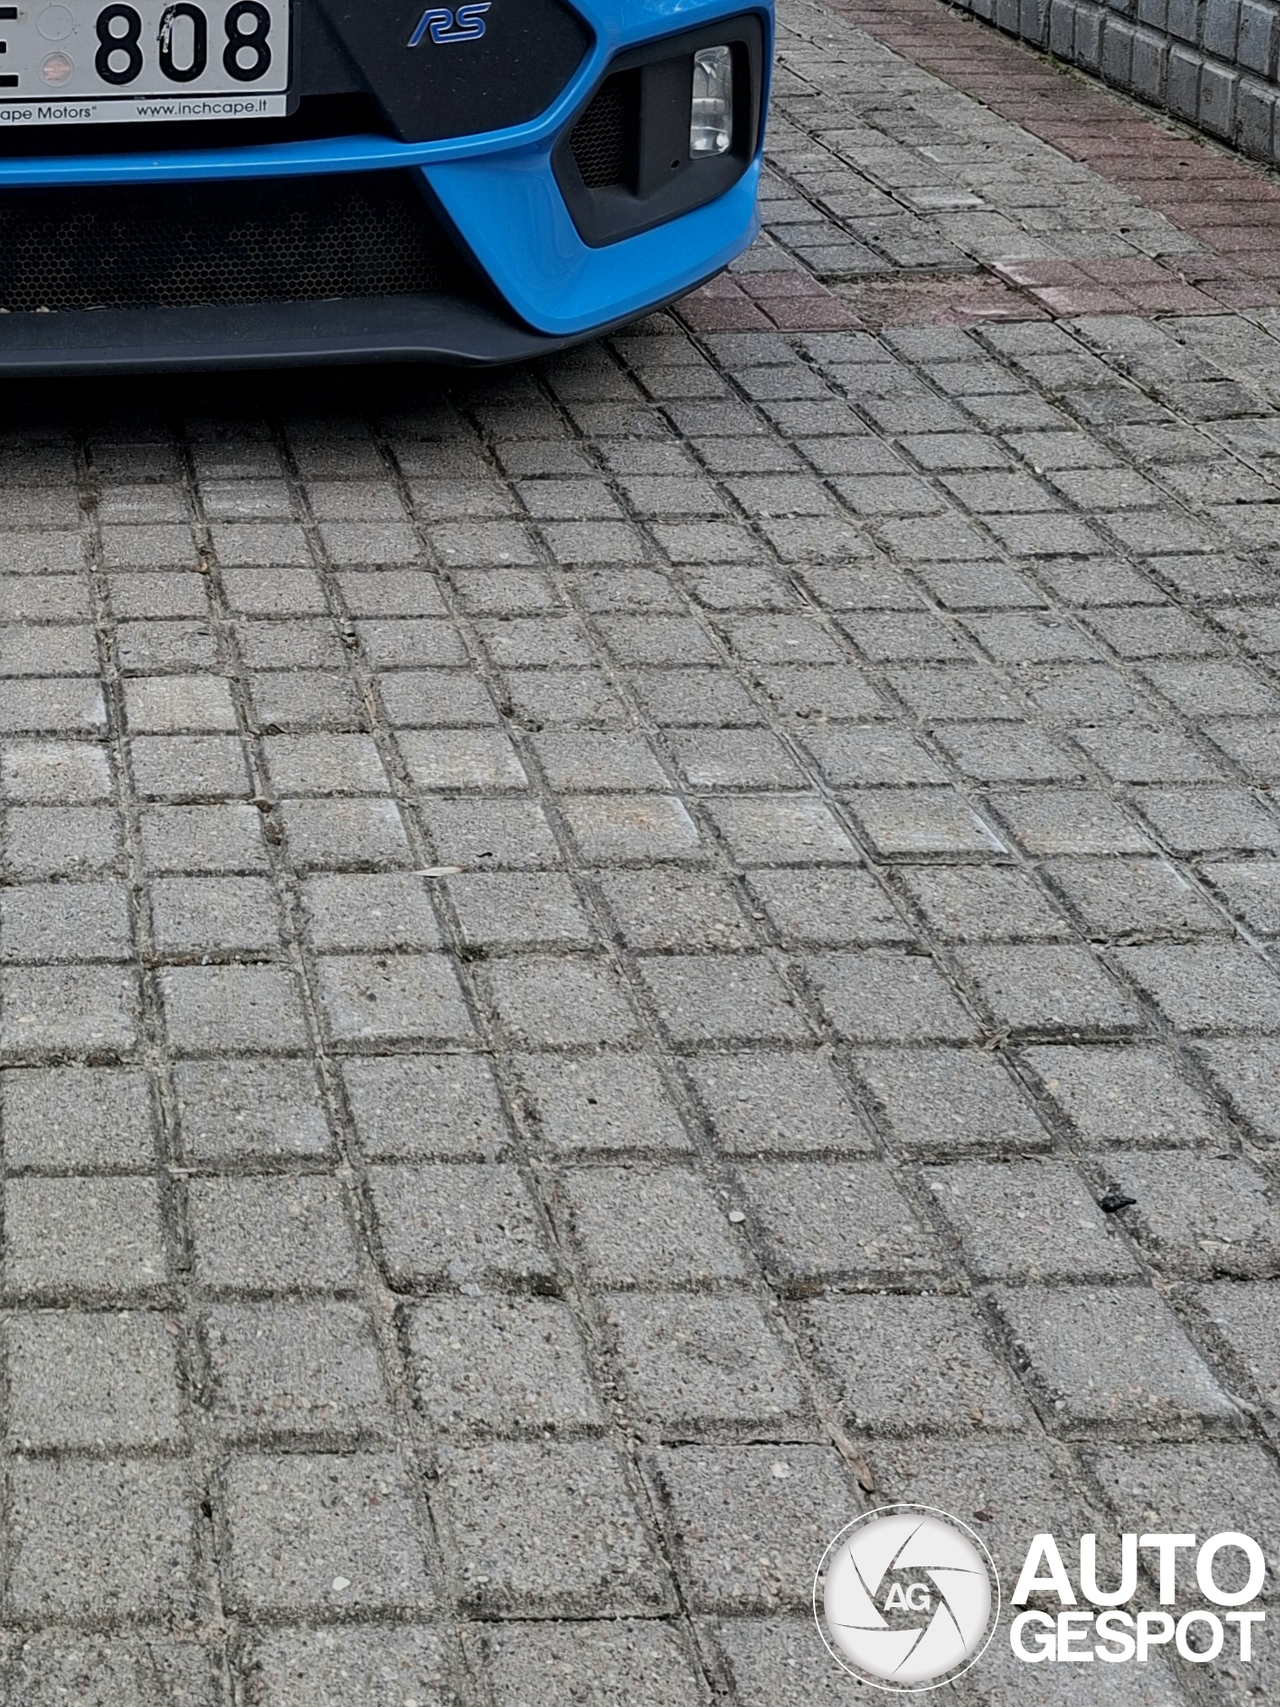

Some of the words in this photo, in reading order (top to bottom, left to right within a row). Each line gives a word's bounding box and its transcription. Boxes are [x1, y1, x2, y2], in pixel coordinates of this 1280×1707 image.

[94, 0, 272, 85] 808
[406, 1, 492, 47] RS
[136, 99, 268, 117] www.inchcape.lt
